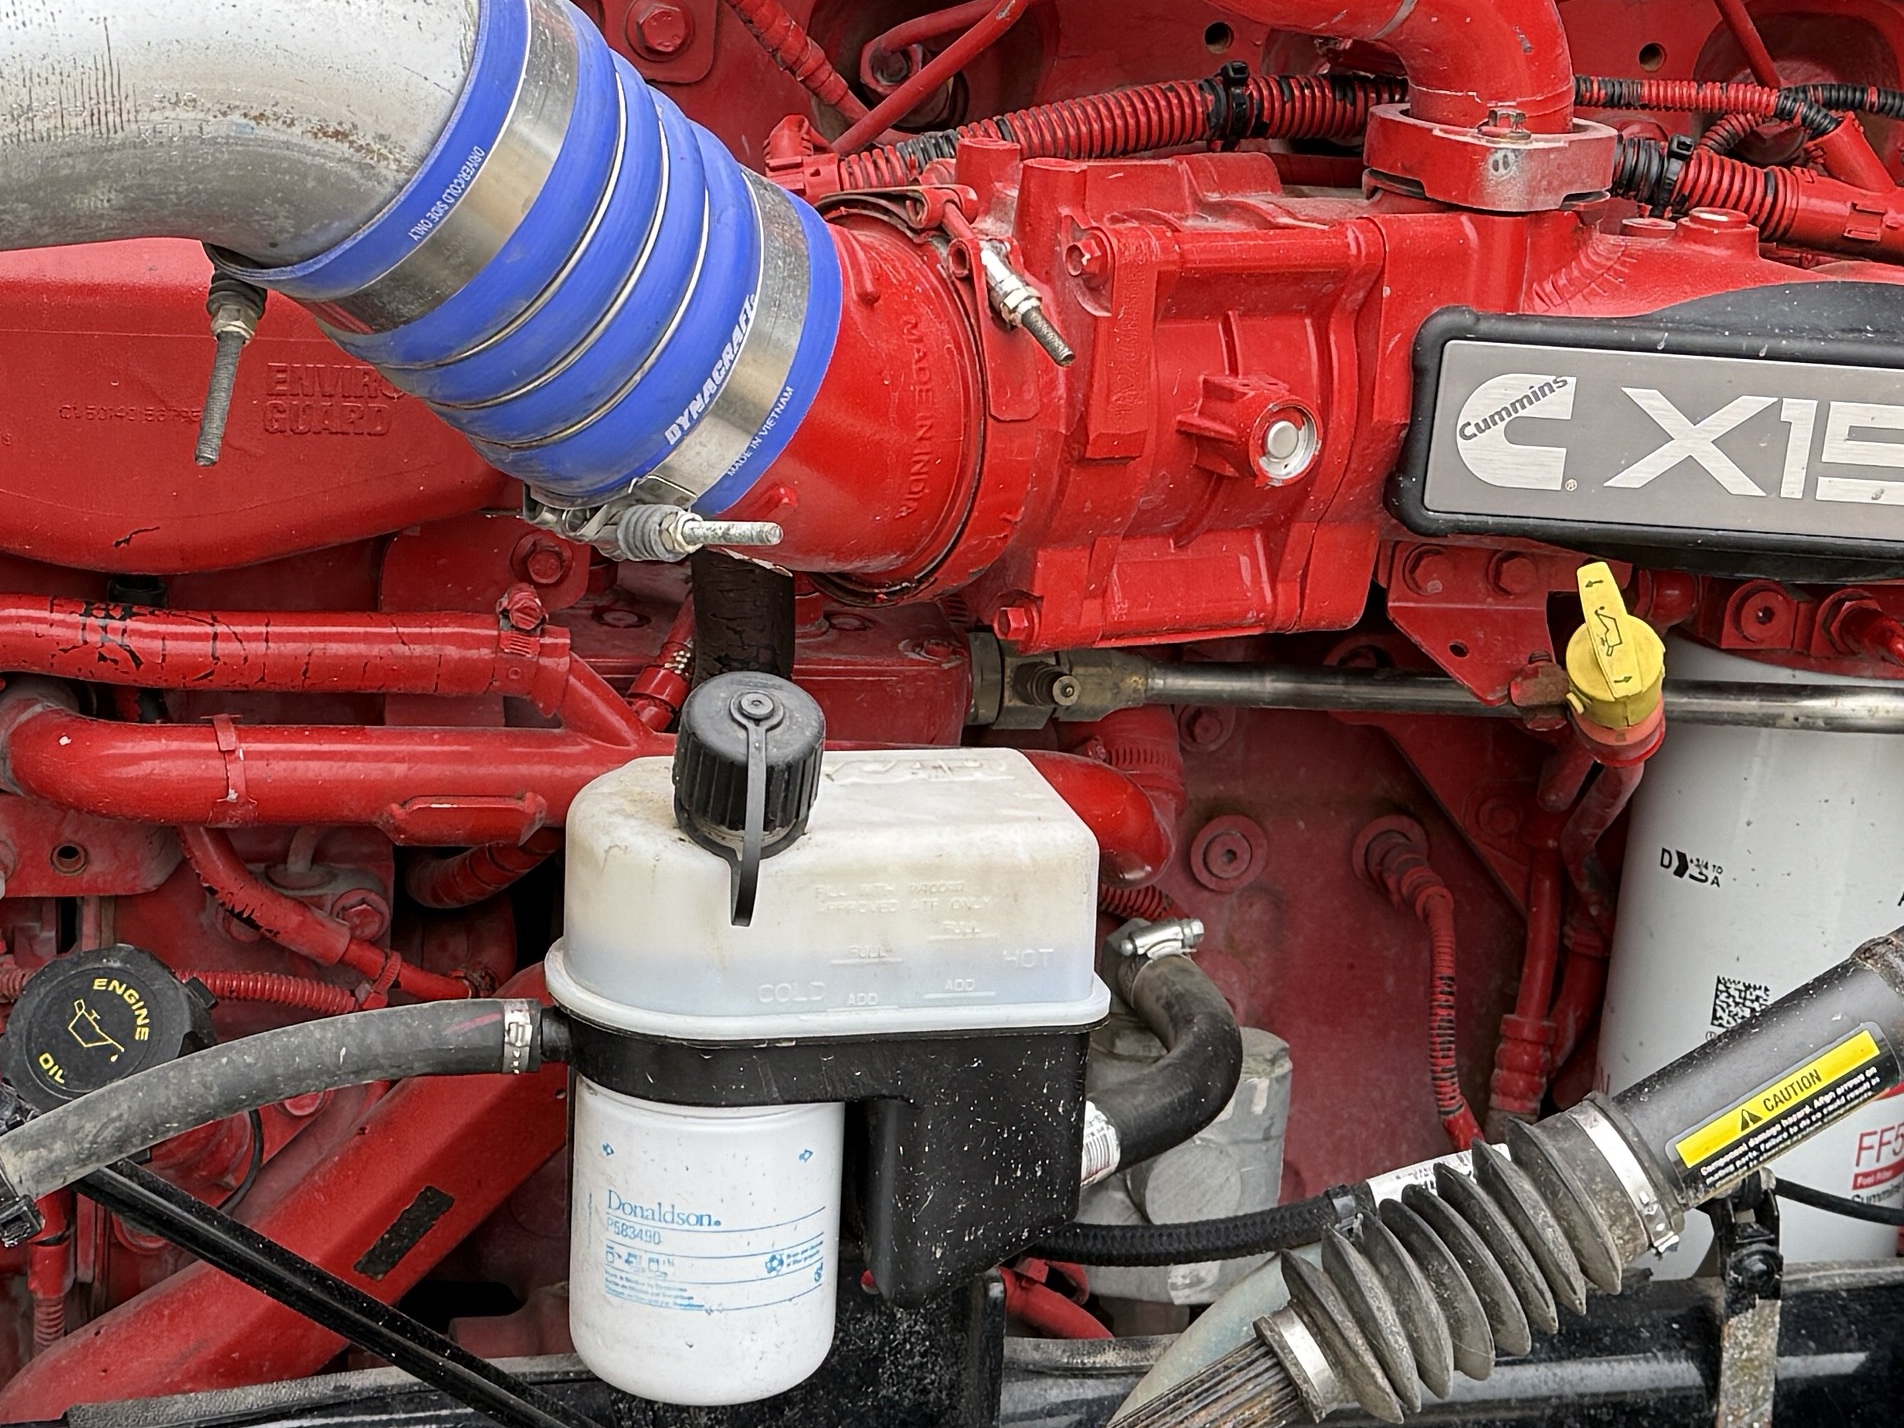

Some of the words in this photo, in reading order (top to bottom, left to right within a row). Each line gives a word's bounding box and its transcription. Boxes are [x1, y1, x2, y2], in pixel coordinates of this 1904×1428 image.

[425, 198, 449, 224] SIDE
[407, 217, 433, 242] ONLY
[664, 293, 754, 446] DYNACRAFT
[262, 401, 392, 437] GUARD
[748, 435, 762, 449] IN
[758, 385, 794, 435] VIETNAM
[1457, 374, 1569, 443] Cummins
[1660, 846, 1673, 870] D
[1001, 948, 1055, 970] HOT
[757, 981, 826, 1004] COLD
[847, 992, 879, 1007] ADD
[944, 978, 976, 993] ADD
[92, 978, 150, 1042] ENGINE
[38, 1052, 65, 1084] OIL
[1761, 1067, 1823, 1113] CAUTION
[607, 1189, 714, 1227] Donaldson
